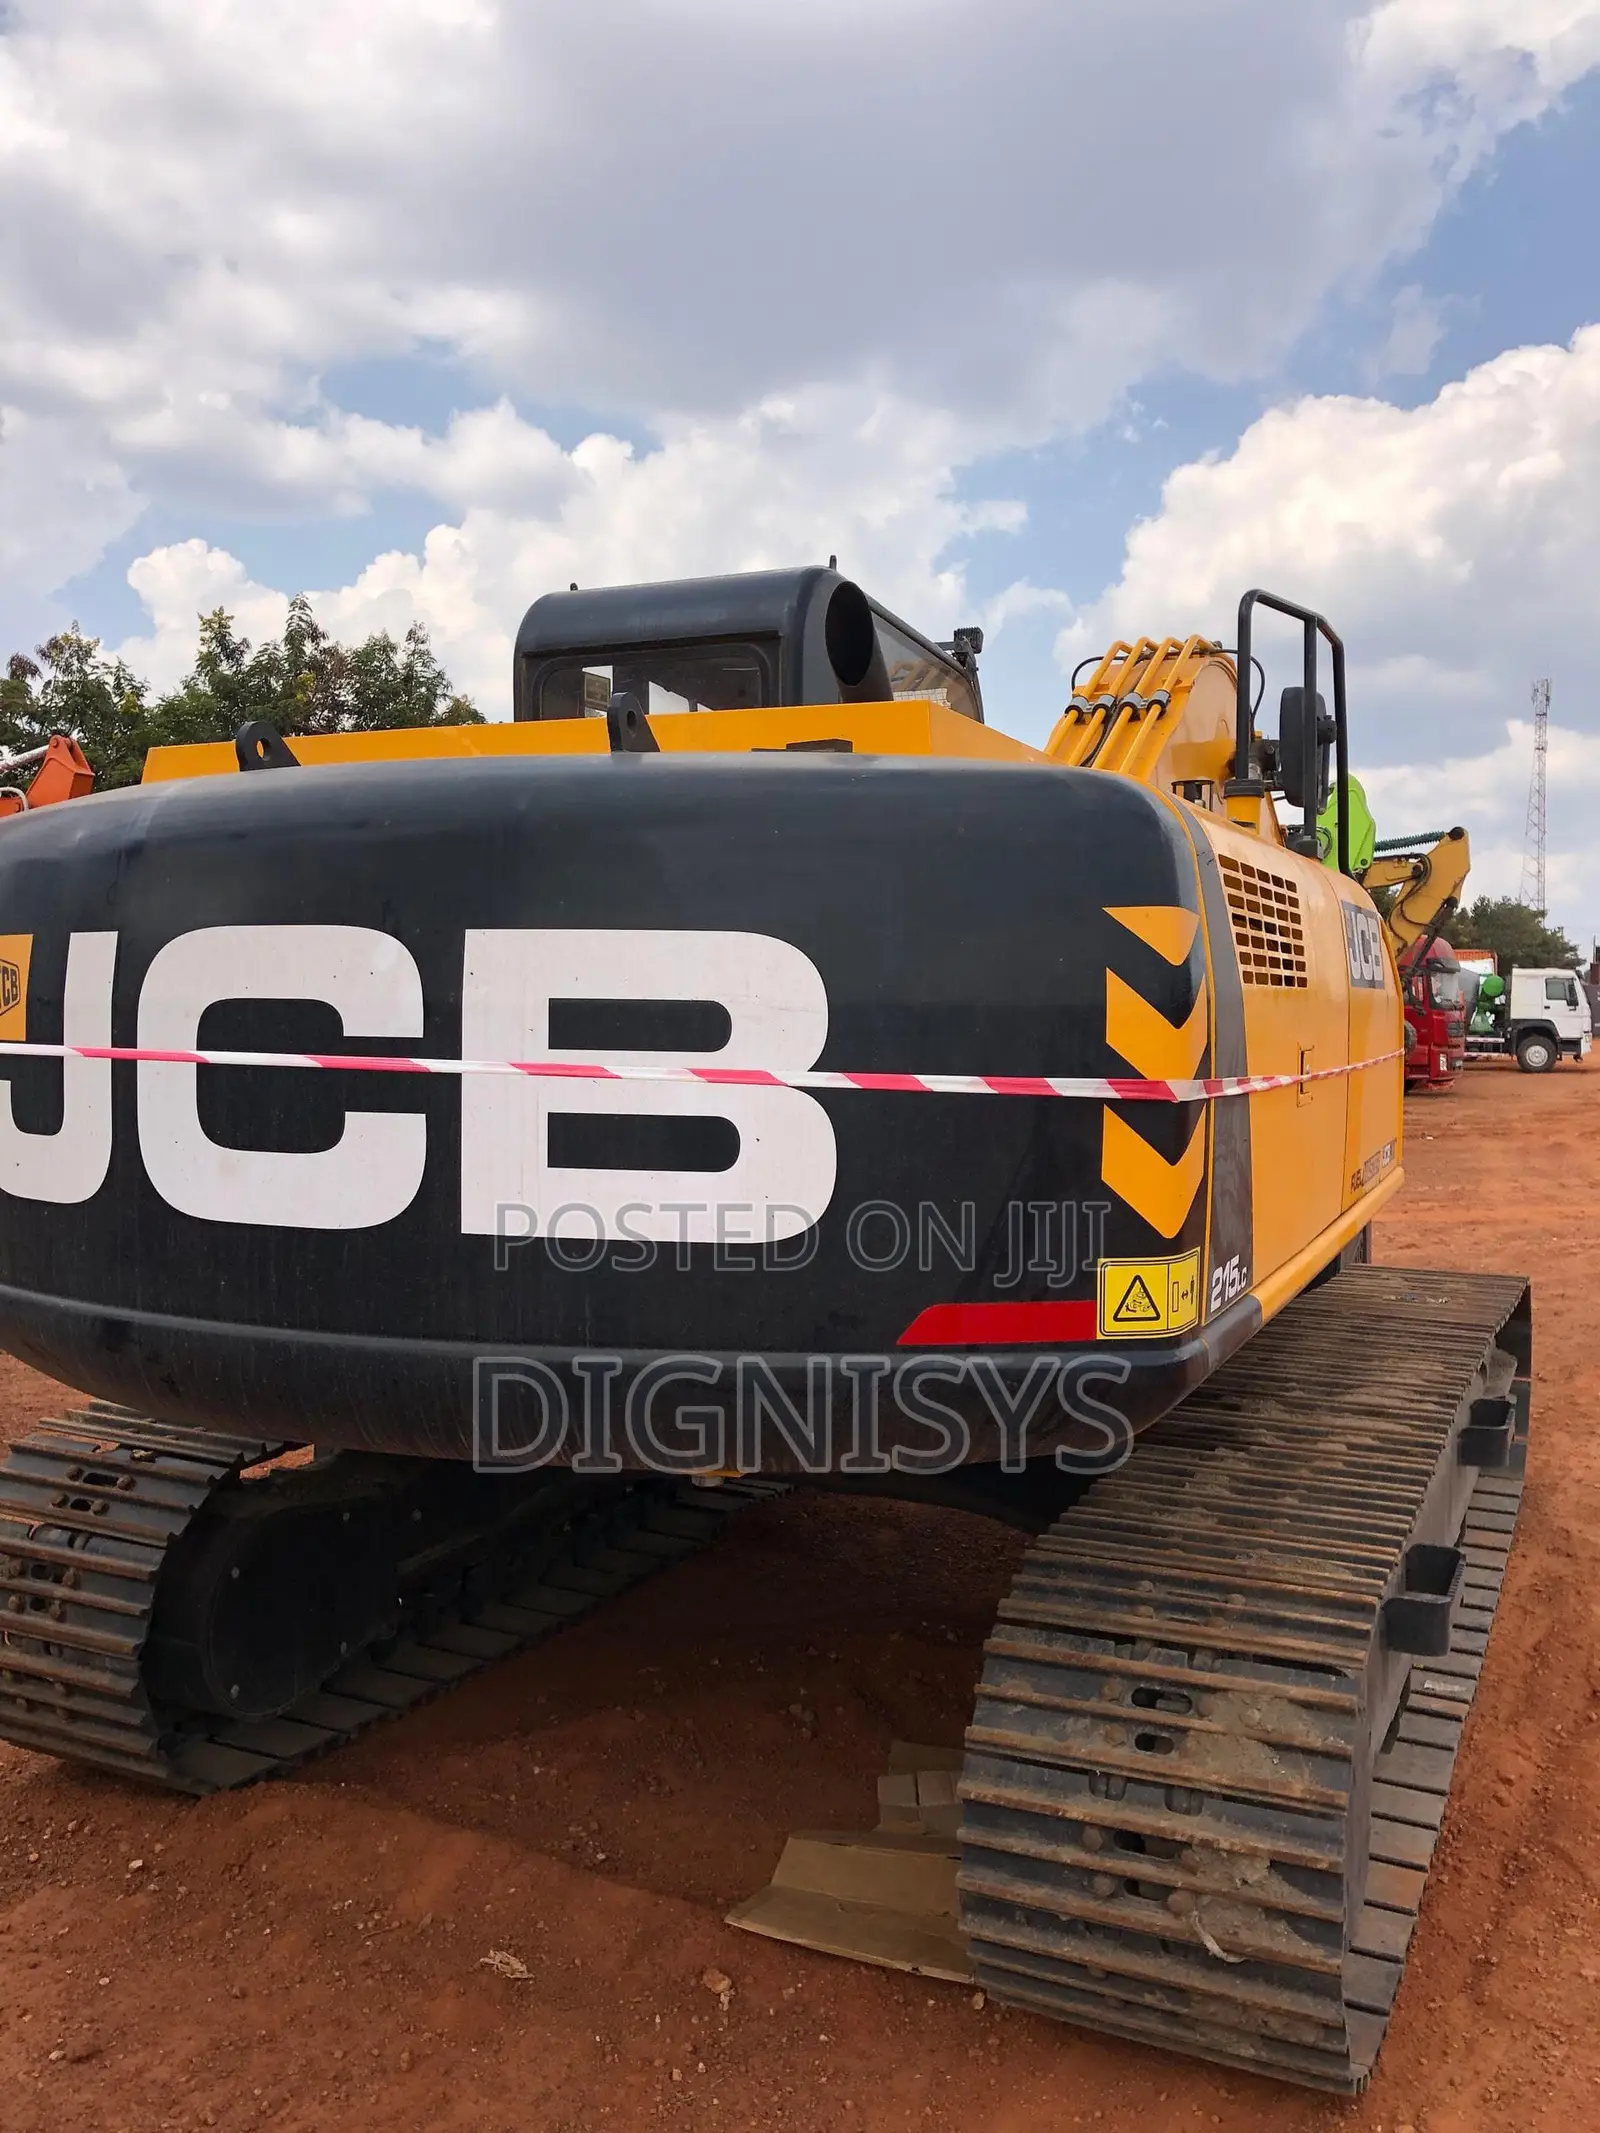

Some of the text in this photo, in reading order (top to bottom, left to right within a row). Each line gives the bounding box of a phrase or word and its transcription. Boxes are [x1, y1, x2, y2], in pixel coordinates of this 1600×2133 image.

[1345, 909, 1384, 981] JCB
[0, 965, 18, 1007] CB
[0, 925, 838, 1245] JCB
